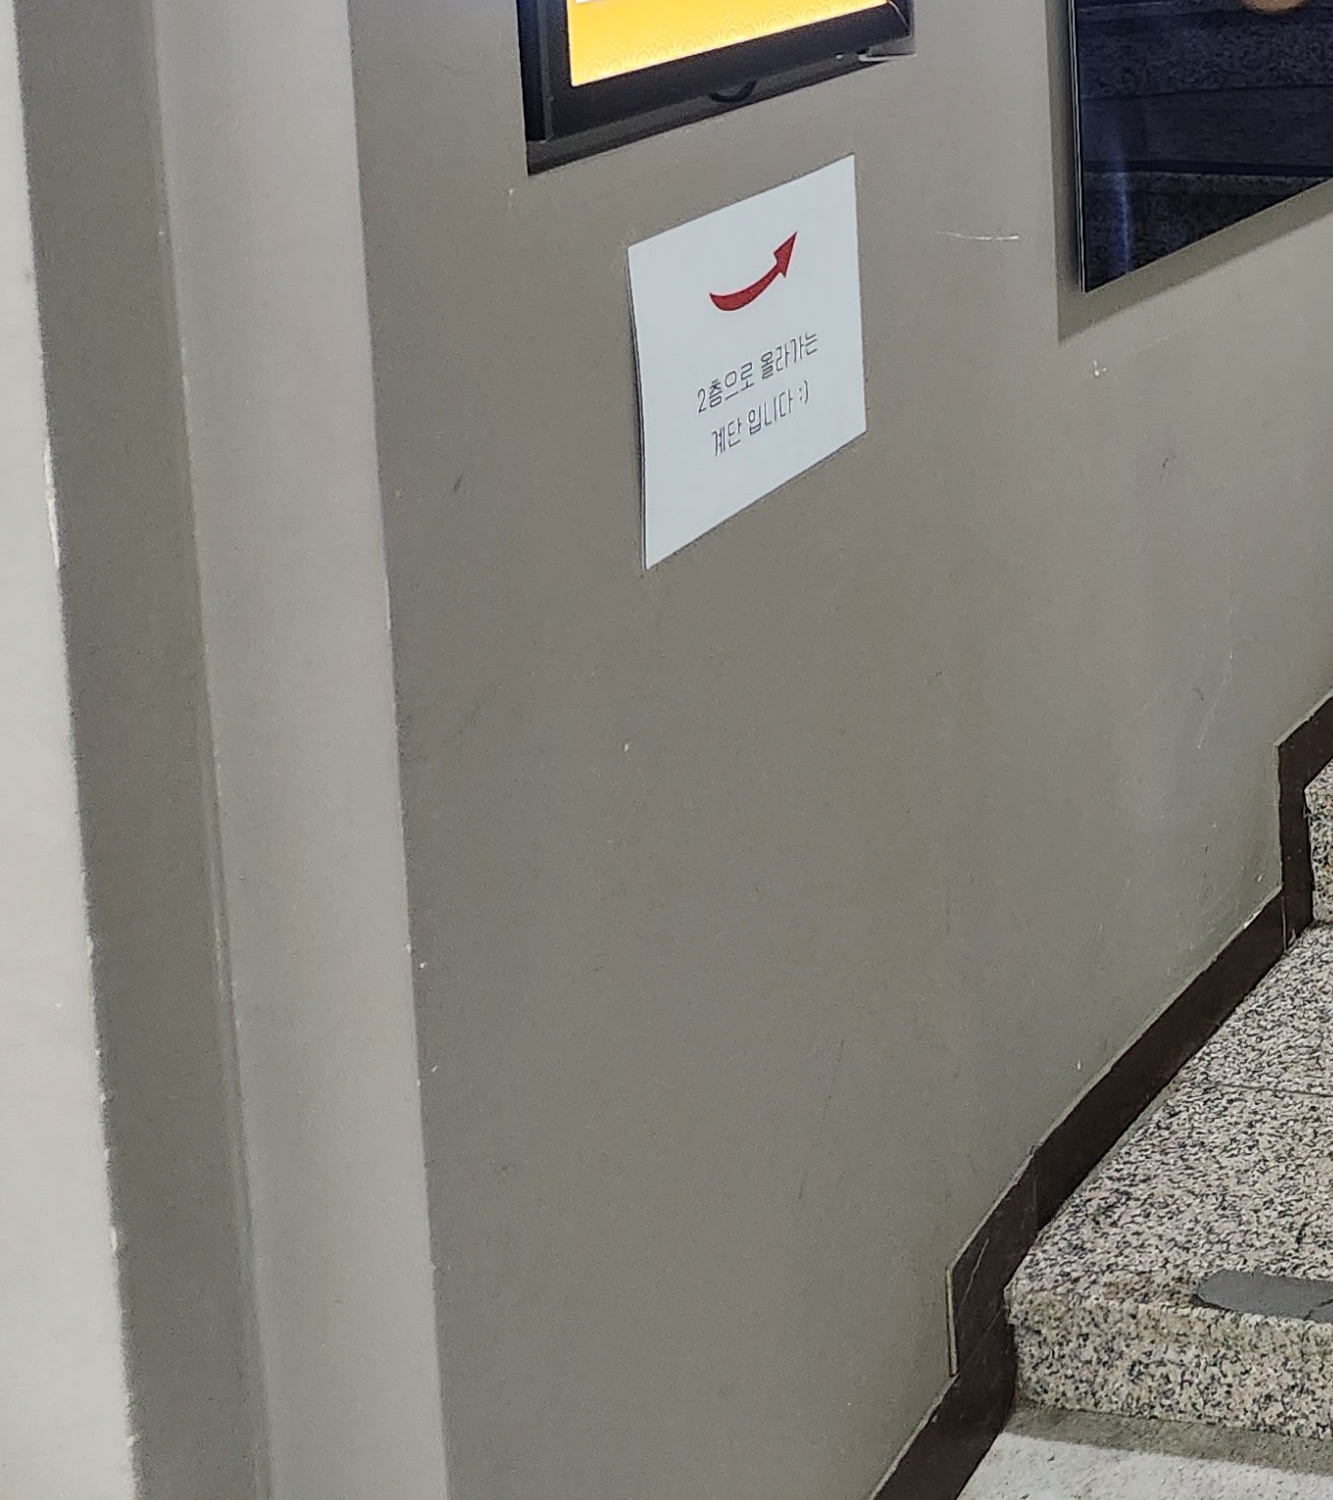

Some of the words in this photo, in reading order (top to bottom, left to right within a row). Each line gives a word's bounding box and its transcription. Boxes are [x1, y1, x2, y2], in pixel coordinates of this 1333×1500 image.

[696, 361, 756, 415] 2층으로
[760, 332, 818, 380] 올라가는
[711, 417, 743, 457] 계단
[747, 388, 794, 436] 입니다
